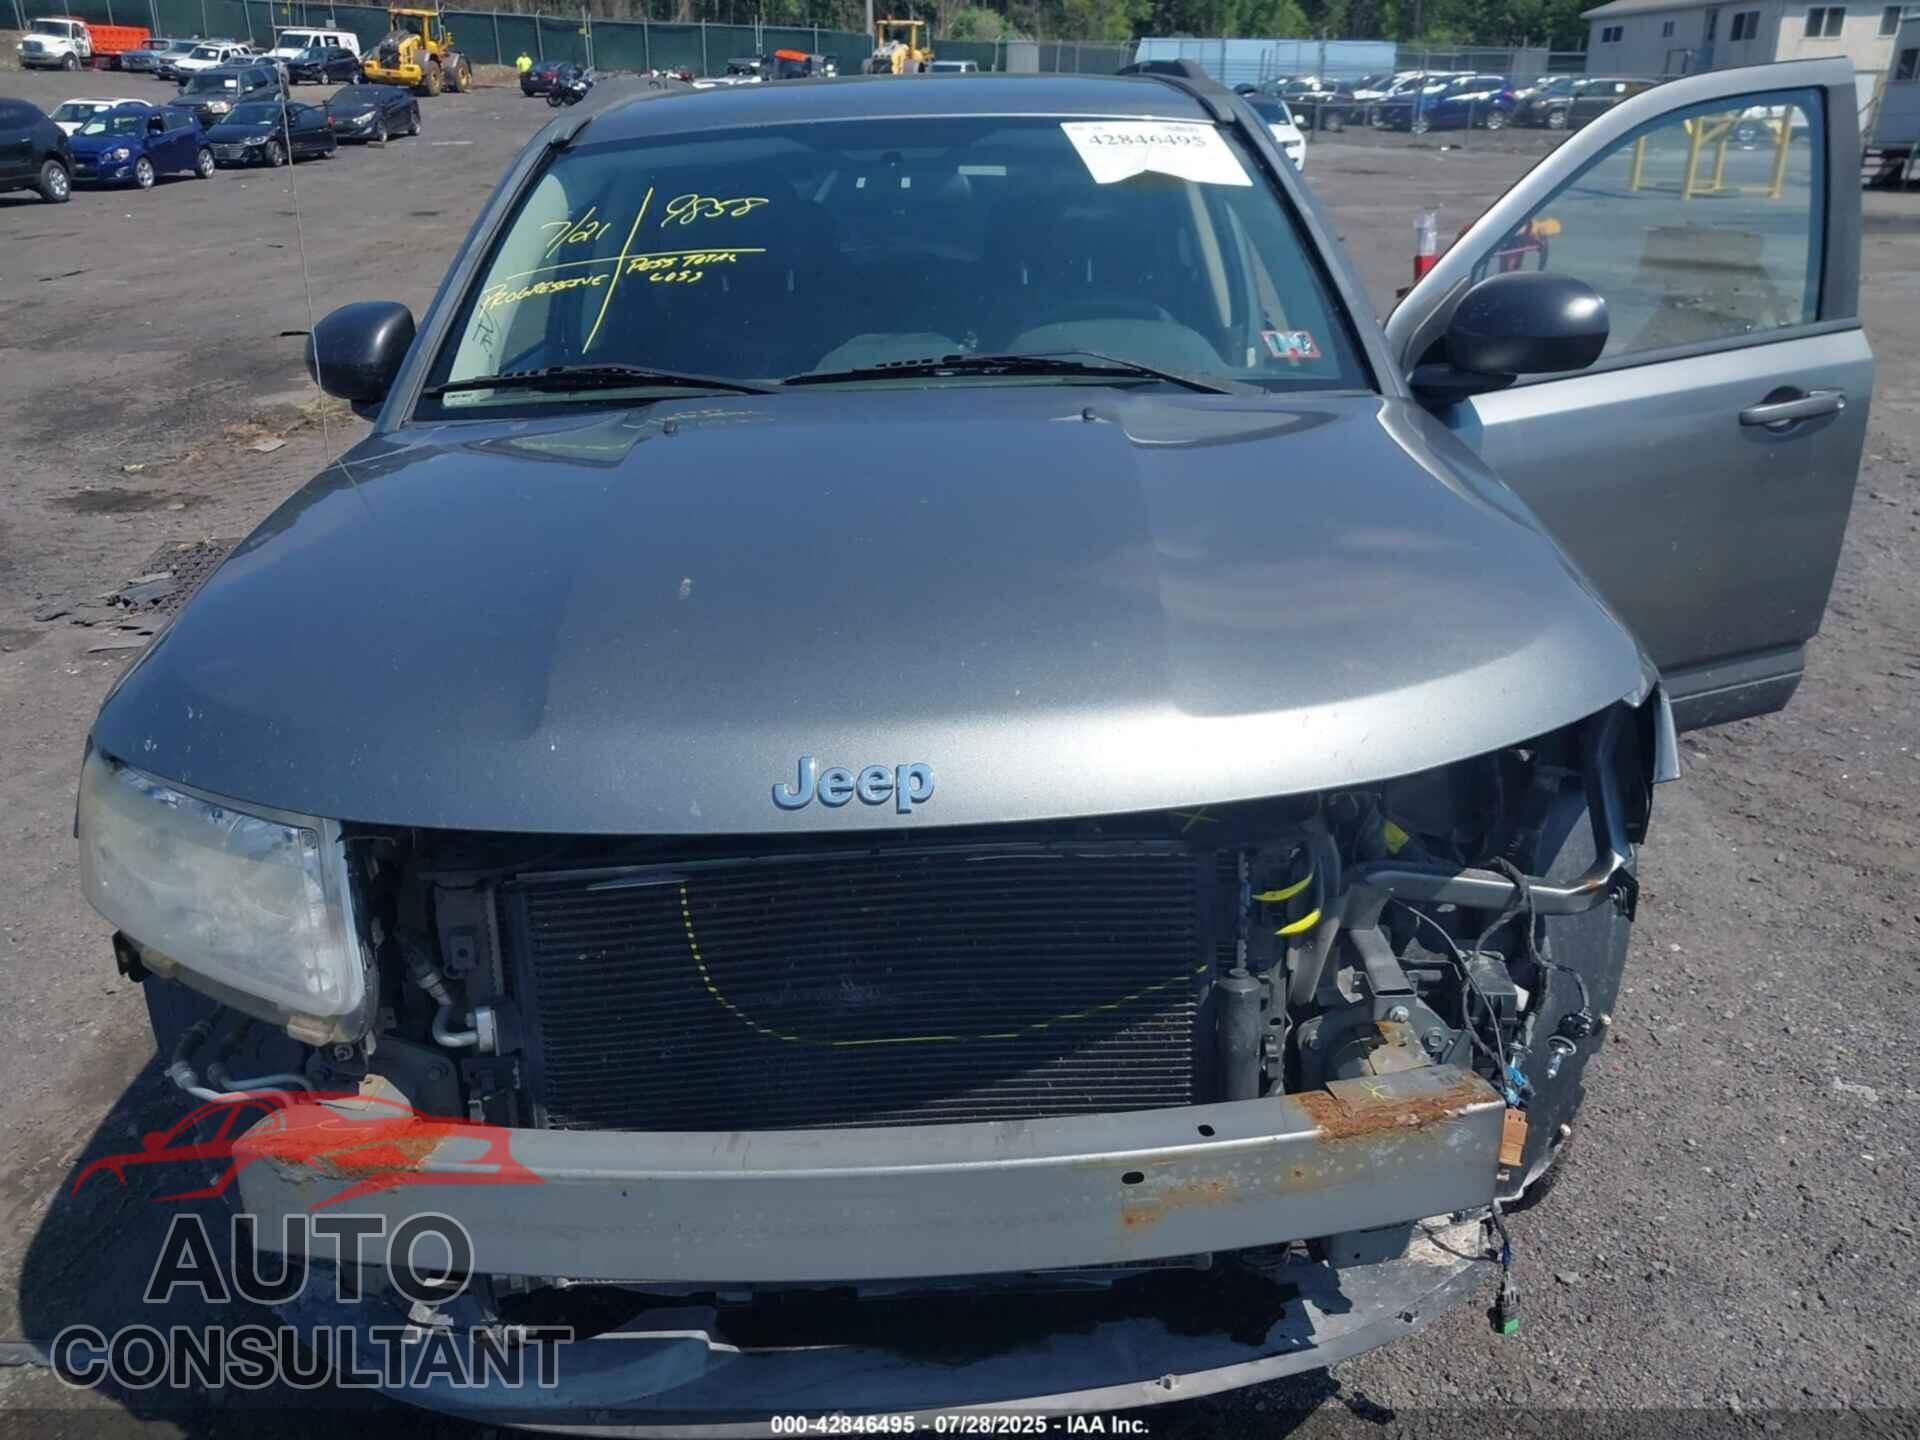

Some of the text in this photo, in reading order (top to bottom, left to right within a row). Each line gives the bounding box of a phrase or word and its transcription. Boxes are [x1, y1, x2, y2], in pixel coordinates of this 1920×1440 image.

[541, 206, 612, 259] 7/21
[478, 274, 610, 320] PROGRESSIVE
[772, 752, 936, 814] Jeep
